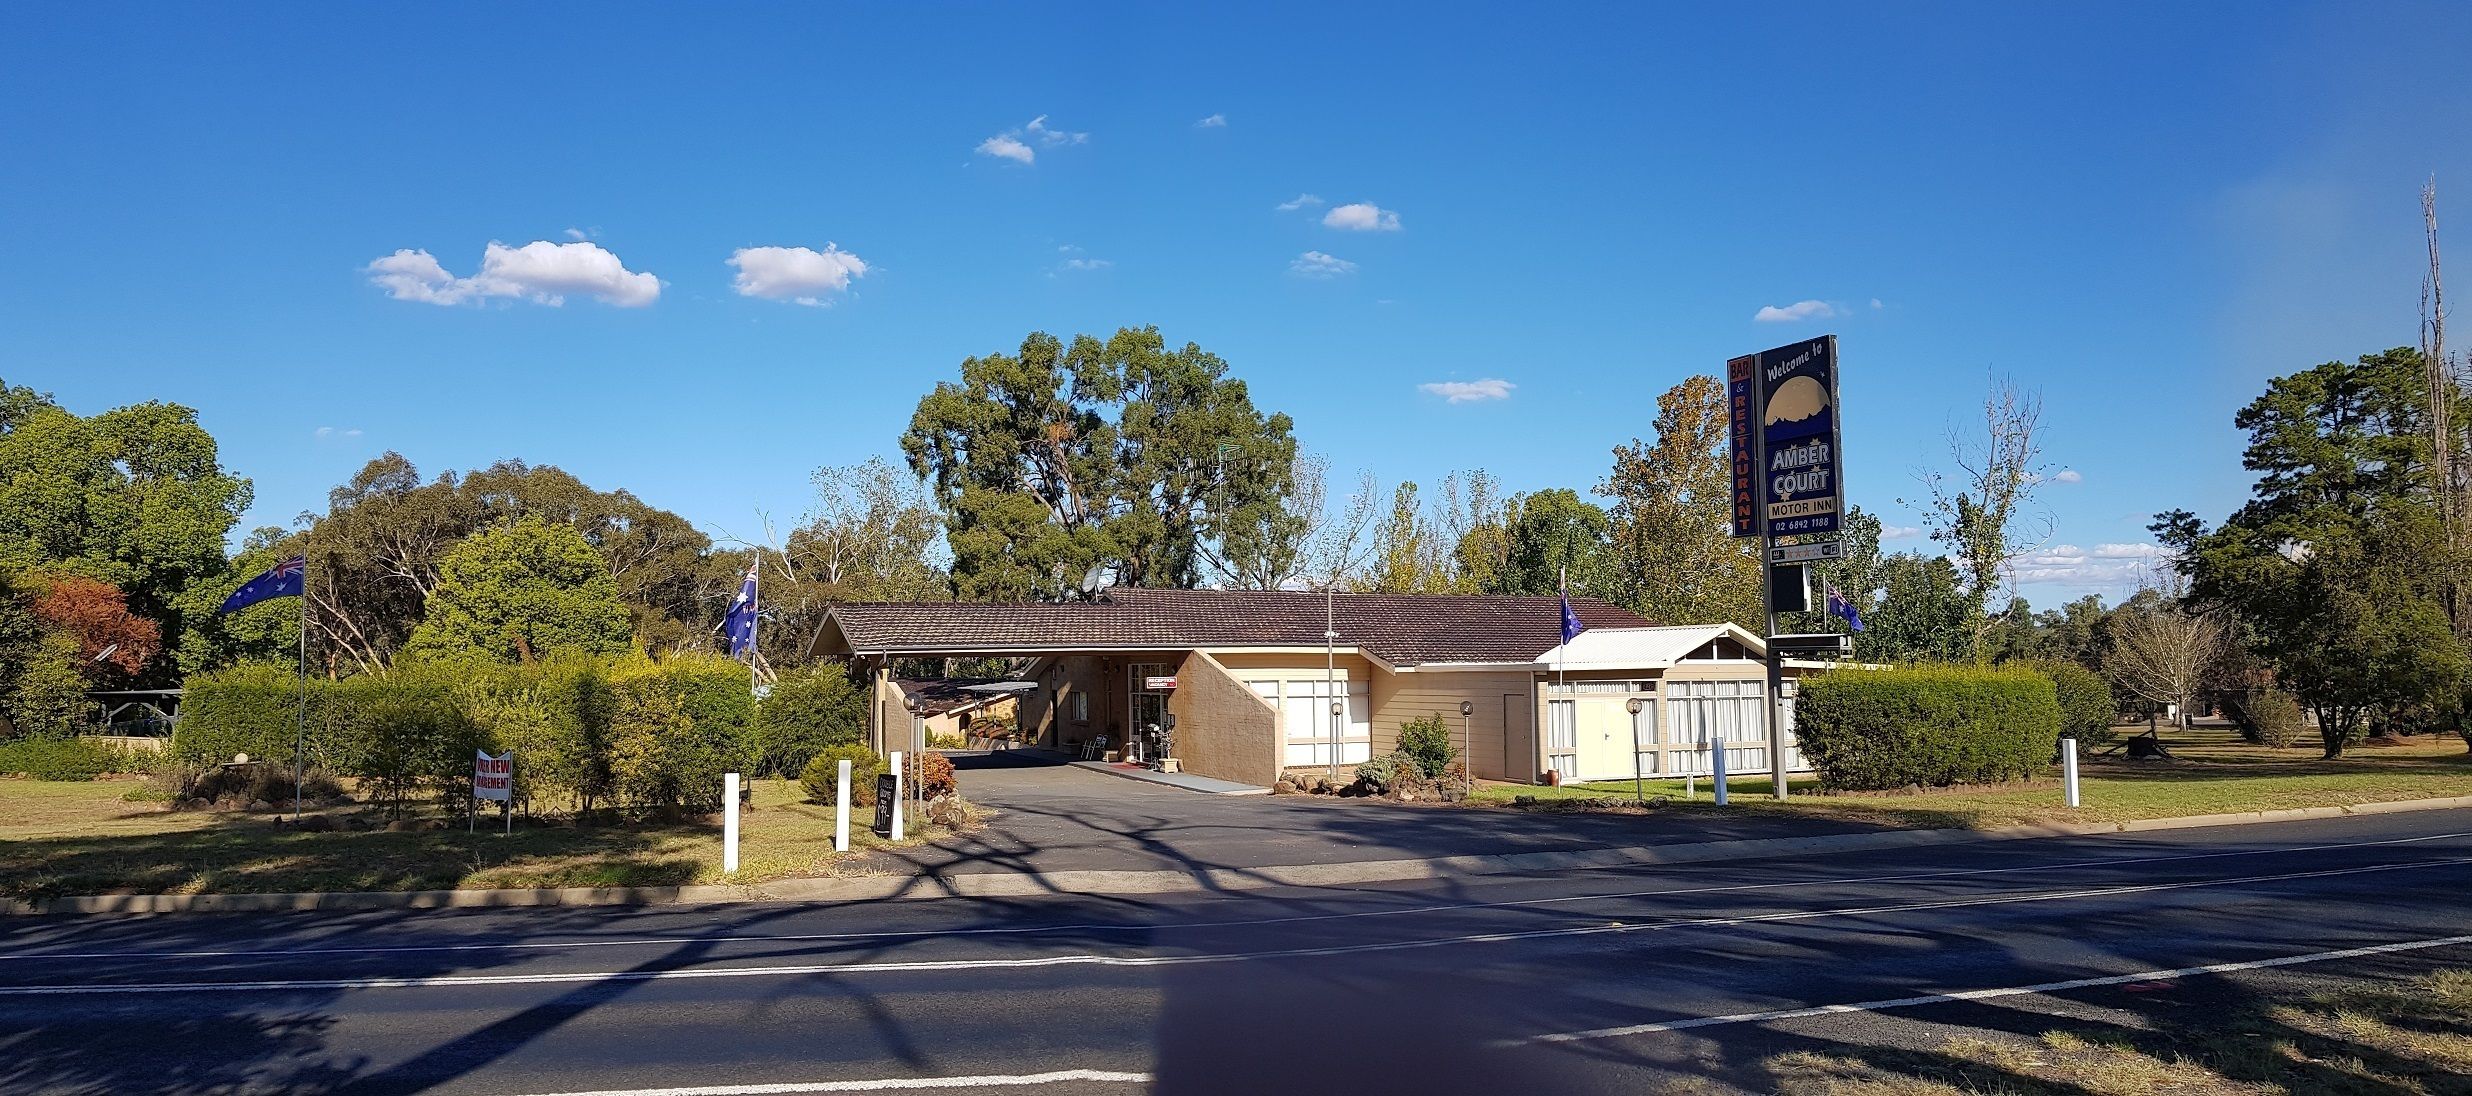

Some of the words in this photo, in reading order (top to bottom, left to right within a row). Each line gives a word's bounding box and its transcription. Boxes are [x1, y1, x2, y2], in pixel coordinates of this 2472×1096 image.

[1730, 361, 1749, 380] BAR
[1767, 351, 1810, 382] Welcome
[1812, 342, 1823, 357] to
[1735, 395, 1751, 530] RESTAURANT
[1771, 443, 1830, 471] AMBER
[1773, 469, 1829, 496] COURT
[1772, 503, 1809, 517] MOTOR
[1813, 500, 1832, 512] INN
[1775, 522, 1785, 532] 02
[1788, 520, 1808, 531] 6842
[1811, 517, 1829, 528] 1188
[490, 759, 510, 774] NEW
